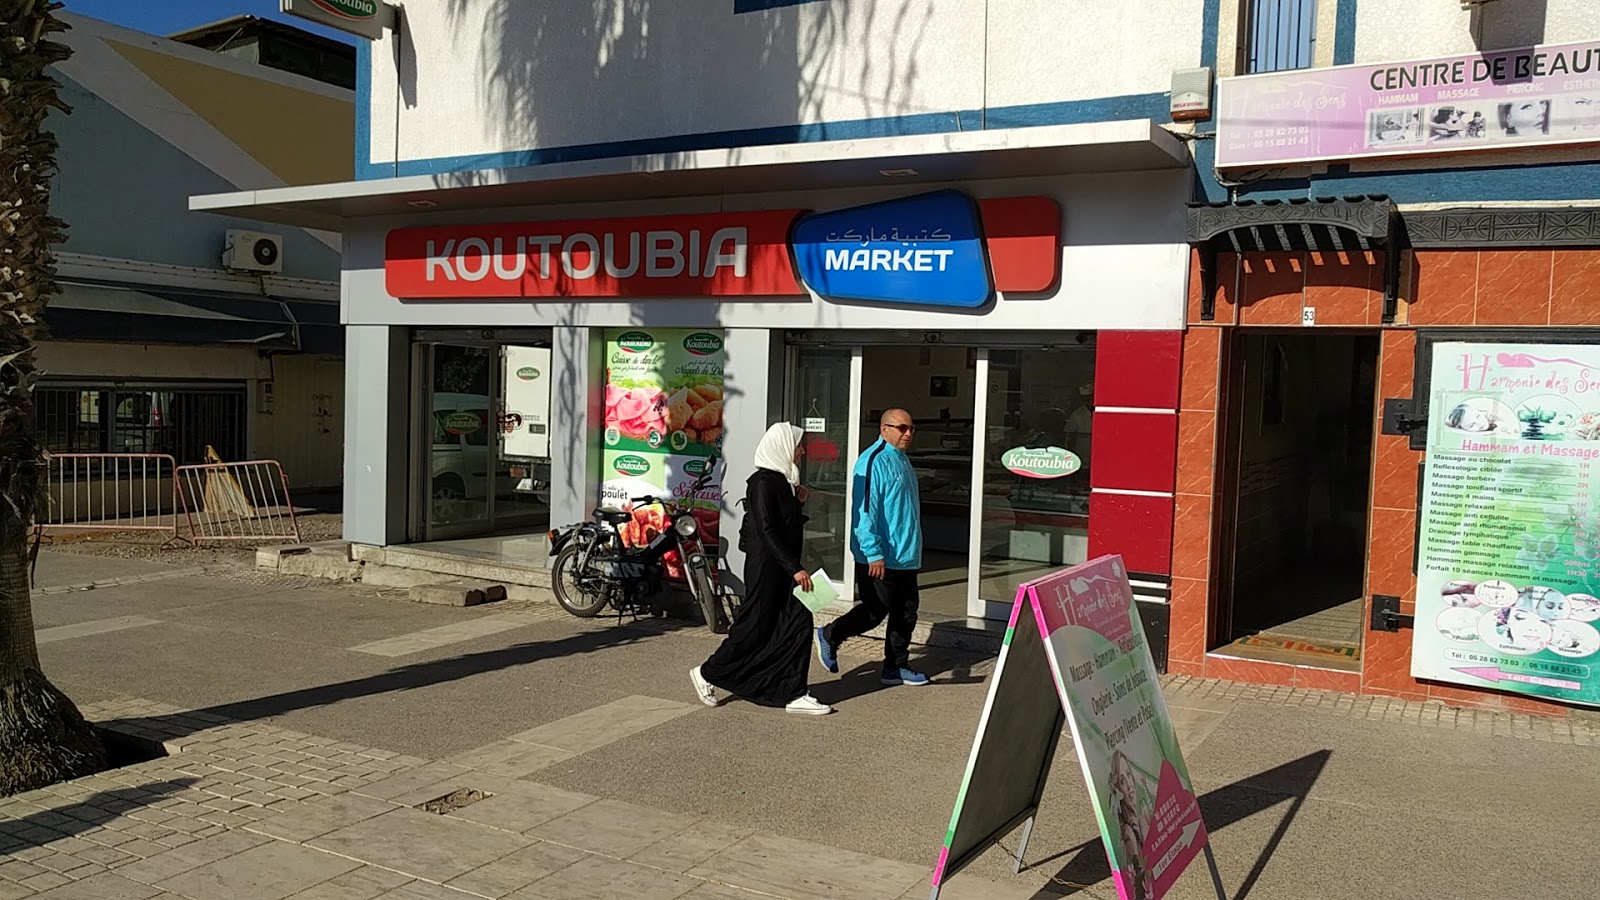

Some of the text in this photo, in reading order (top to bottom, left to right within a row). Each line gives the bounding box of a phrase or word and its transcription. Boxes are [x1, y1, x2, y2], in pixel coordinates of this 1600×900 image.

[1371, 62, 1465, 91] CENTRE
[1473, 58, 1507, 82] DE
[1437, 87, 1480, 100] MASSAGE
[1506, 82, 1544, 94] PIERCING
[1315, 86, 1346, 109] Sens
[1378, 93, 1419, 105] HAMMAM
[1287, 126, 1297, 136] 73
[1299, 125, 1309, 134] 03
[1299, 136, 1309, 145] 43
[825, 226, 952, 248] كتبية ماركت
[426, 226, 748, 282] KOUTOUBIA
[825, 249, 954, 272] MARKET
[1304, 310, 1315, 321] 53
[1457, 353, 1540, 393] Harmonie
[1545, 370, 1569, 394] des
[1462, 440, 1600, 460] Hammam et Massage
[1008, 454, 1074, 469] Koutoubia
[1433, 454, 1466, 462] Massage
[616, 461, 649, 472] Koutoubia
[1432, 472, 1464, 480] Massage
[602, 487, 628, 500] poulet
[1432, 482, 1464, 490] Massage
[1466, 484, 1496, 492] tonifiant
[1431, 491, 1463, 499] Massage
[1430, 500, 1463, 509] Massage
[1464, 503, 1496, 511] relaxant
[1430, 509, 1462, 518] Massage
[1429, 518, 1461, 527] Massage
[1479, 523, 1527, 532] rhumatismal
[1428, 528, 1509, 540] Drainage lymphatique
[1428, 537, 1460, 545] Massage
[1482, 542, 1523, 550] chauffante
[1427, 546, 1462, 554] Hammam
[1464, 550, 1501, 558] gommage
[1426, 555, 1461, 563] Hammam
[1463, 559, 1496, 568] massage
[1426, 564, 1449, 572] Forfait
[1462, 568, 1493, 577] séances
[1495, 571, 1531, 580] hammam
[1542, 577, 1578, 586] massage
[1069, 660, 1093, 684] Massage
[1091, 688, 1114, 716] Onglerie
[1113, 680, 1128, 701] Soins
[1104, 724, 1127, 751] Piercing
[1157, 857, 1170, 872] 1er
